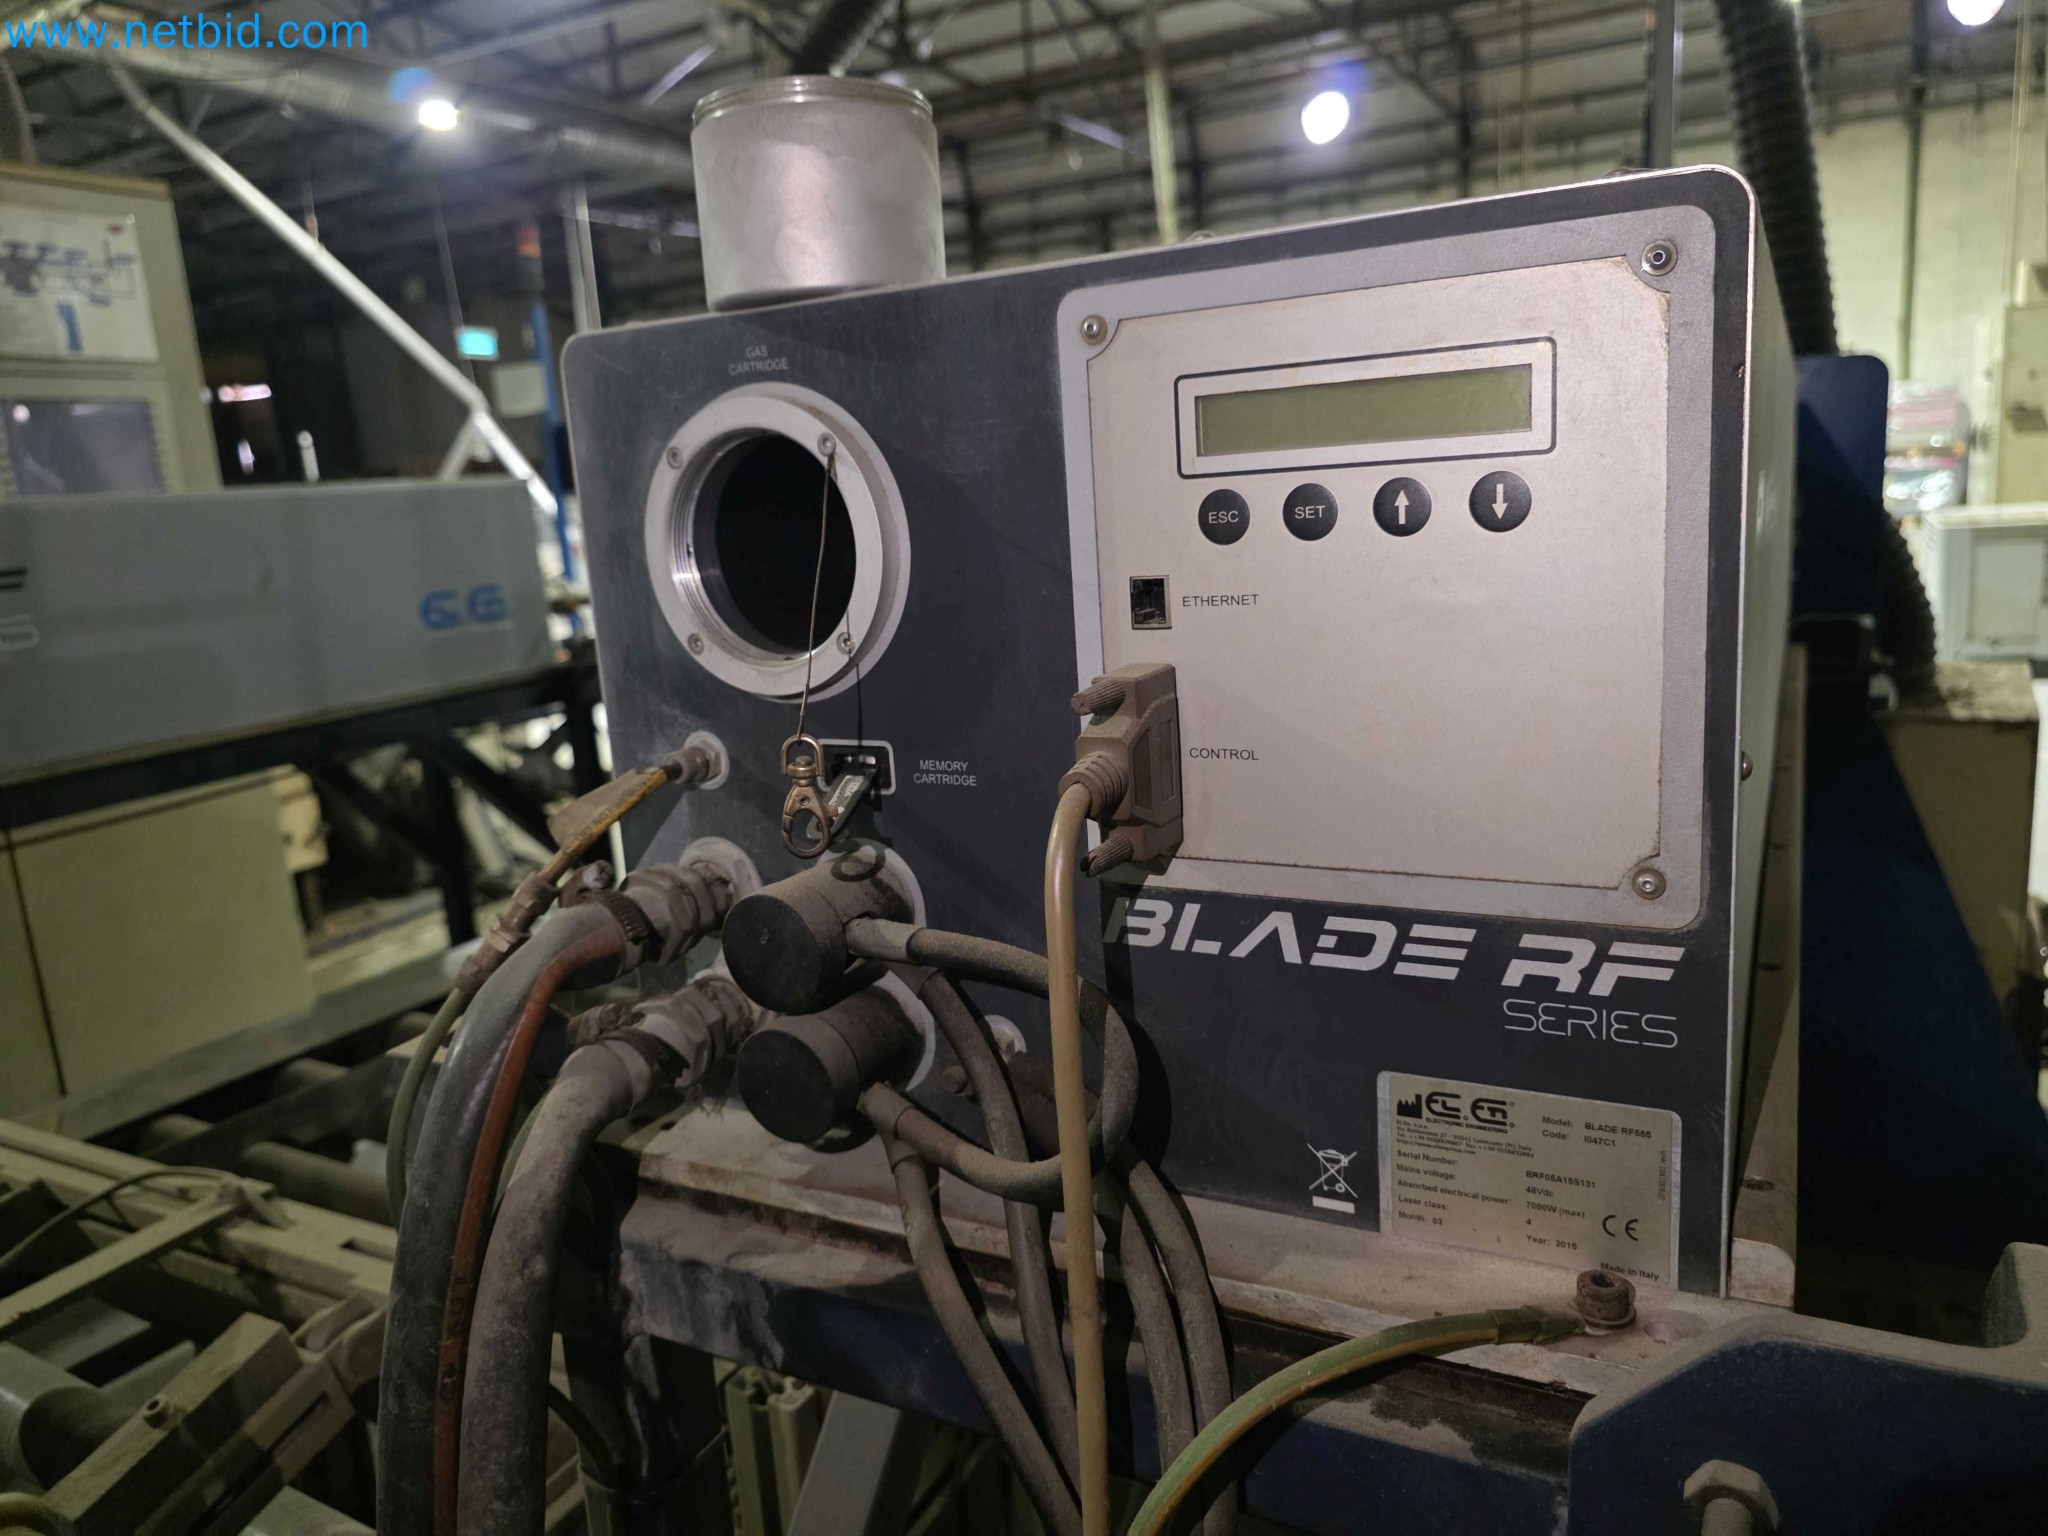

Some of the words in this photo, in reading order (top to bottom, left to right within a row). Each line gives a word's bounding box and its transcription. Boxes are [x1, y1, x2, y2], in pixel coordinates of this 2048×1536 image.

[746, 345, 768, 358] GAS
[729, 357, 789, 376] CARTRIDGE
[1208, 511, 1239, 524] ESC
[1294, 505, 1326, 519] SET
[1182, 594, 1260, 607] ETHERNET
[1189, 747, 1259, 760] CONTROL
[919, 760, 968, 772] MEMORY
[913, 773, 977, 786] CARTRIDGE
[1104, 897, 1477, 981] BLADE
[1501, 933, 1685, 997] RF
[1503, 999, 1678, 1049] SERIES
[1542, 1116, 1573, 1128] Model:
[1585, 1122, 1618, 1134] BLADE
[1621, 1127, 1652, 1139] RF555
[1542, 1129, 1569, 1141] Code:
[1397, 1149, 1420, 1160] Serial
[1423, 1153, 1458, 1166] Number:
[1526, 1170, 1596, 1189] BRF05A15S131
[1397, 1163, 1421, 1174] Mains
[1423, 1169, 1456, 1180] voltage:
[1526, 1186, 1554, 1197] 48Vdc
[1397, 1180, 1437, 1193] Absorbed
[1440, 1186, 1479, 1199] electrical
[1481, 1195, 1511, 1206] power:
[1526, 1201, 1557, 1213] 7000W
[1559, 1206, 1585, 1219] (max)
[1398, 1195, 1421, 1206] Laser
[1424, 1200, 1448, 1211] class:
[1399, 1210, 1427, 1222] Month:
[1432, 1217, 1443, 1226] 03
[1526, 1234, 1550, 1246] Year:
[1556, 1239, 1578, 1250] 2015
[1601, 1262, 1625, 1274] Made
[1628, 1268, 1638, 1276] in
[1640, 1270, 1660, 1281] Italy
